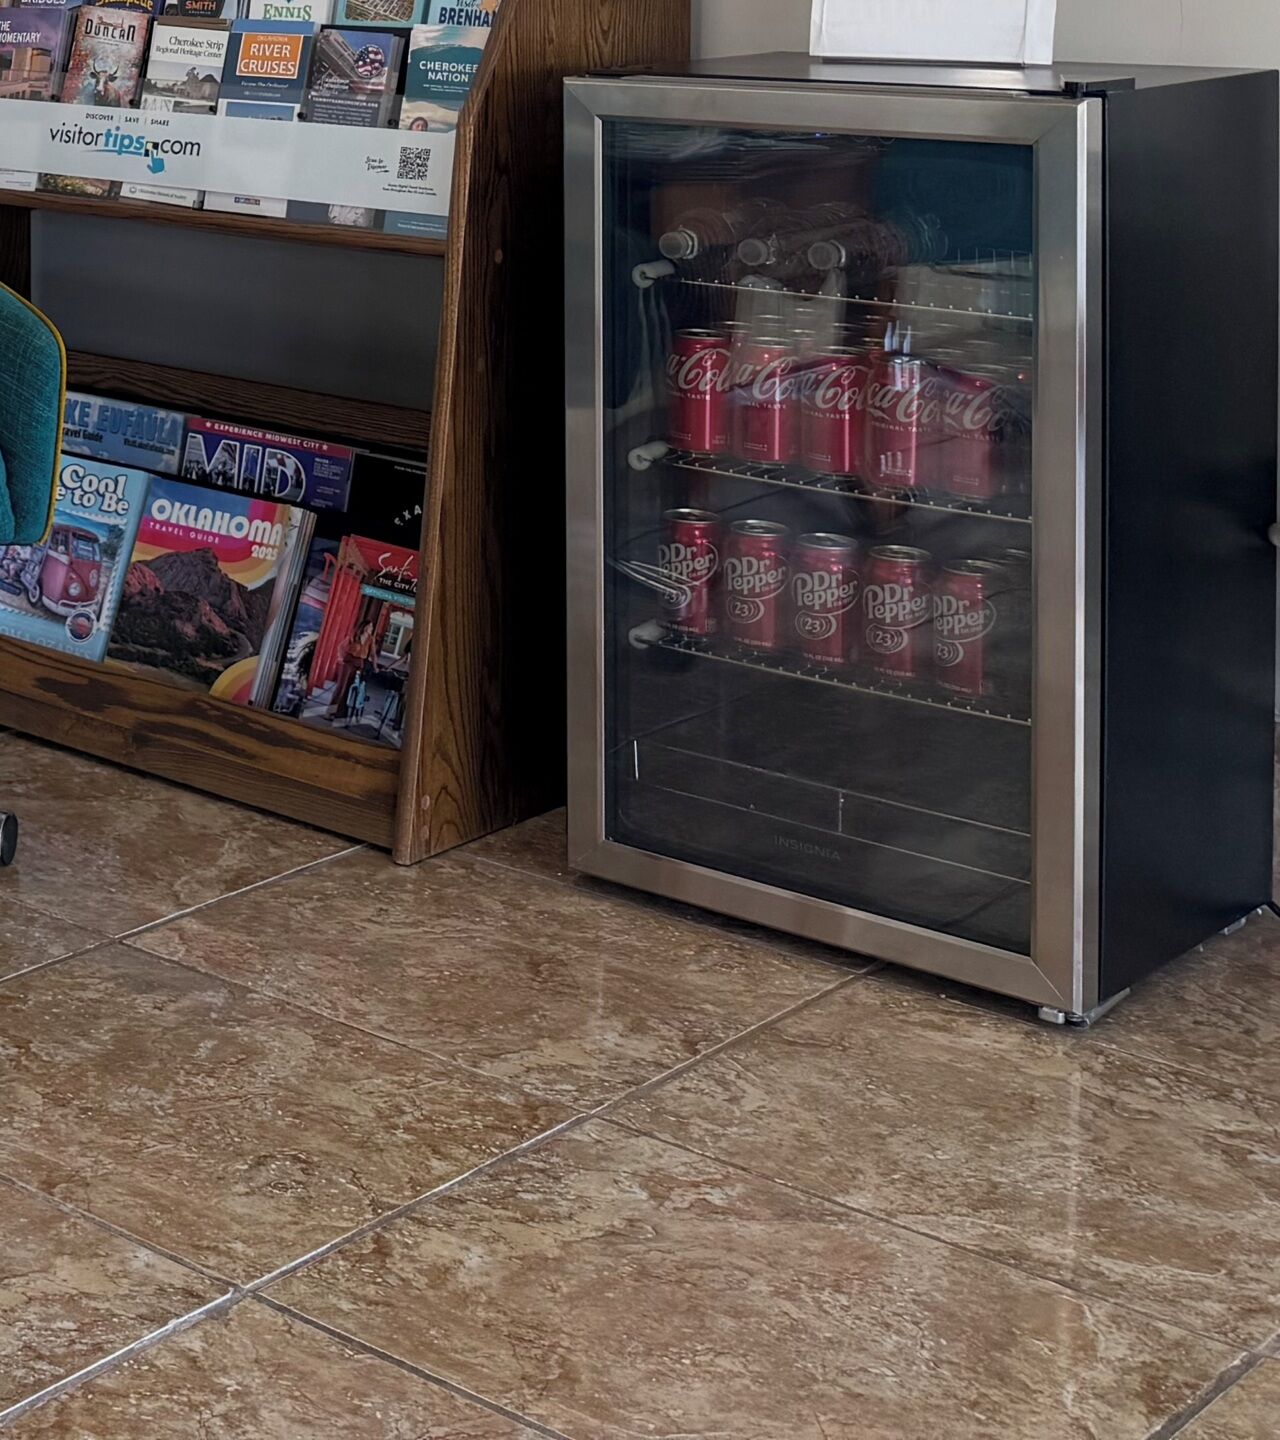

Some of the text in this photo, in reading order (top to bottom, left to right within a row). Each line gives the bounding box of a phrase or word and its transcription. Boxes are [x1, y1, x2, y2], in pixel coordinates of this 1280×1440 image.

[185, 1, 216, 11] SMITH
[263, 3, 312, 21] ENNIS
[155, 45, 222, 58] Regional Heritage Center
[168, 36, 224, 50] Cherokee Strip
[250, 43, 290, 58] RIVER
[240, 59, 295, 75] CRUISES
[419, 61, 480, 73] CHEROKEE
[428, 71, 469, 83] NATION
[85, 112, 170, 127] DISCOVER SAVE SHARE
[96, 404, 179, 448] EUFAULA
[82, 428, 103, 442] Guide
[214, 423, 320, 449] EXPERIENCE MIDWEST CITY
[181, 432, 307, 503] MID
[61, 463, 128, 499] Cool
[71, 487, 130, 515] to Be
[151, 498, 283, 547] OKLAHOMA
[149, 521, 220, 544] TRAVEL GUIDE
[251, 544, 279, 561] 2025
[670, 543, 698, 562] Dr
[739, 556, 771, 572] Dr
[379, 577, 411, 590] THE CITY
[725, 558, 787, 595] Pepper
[812, 571, 843, 588] Dr
[793, 572, 858, 610] Pepper
[883, 583, 914, 602] Dr
[734, 602, 749, 617] 23
[864, 585, 927, 624] Pepper
[942, 596, 969, 614] Dr
[805, 618, 821, 632] 23
[875, 631, 892, 646] 23
